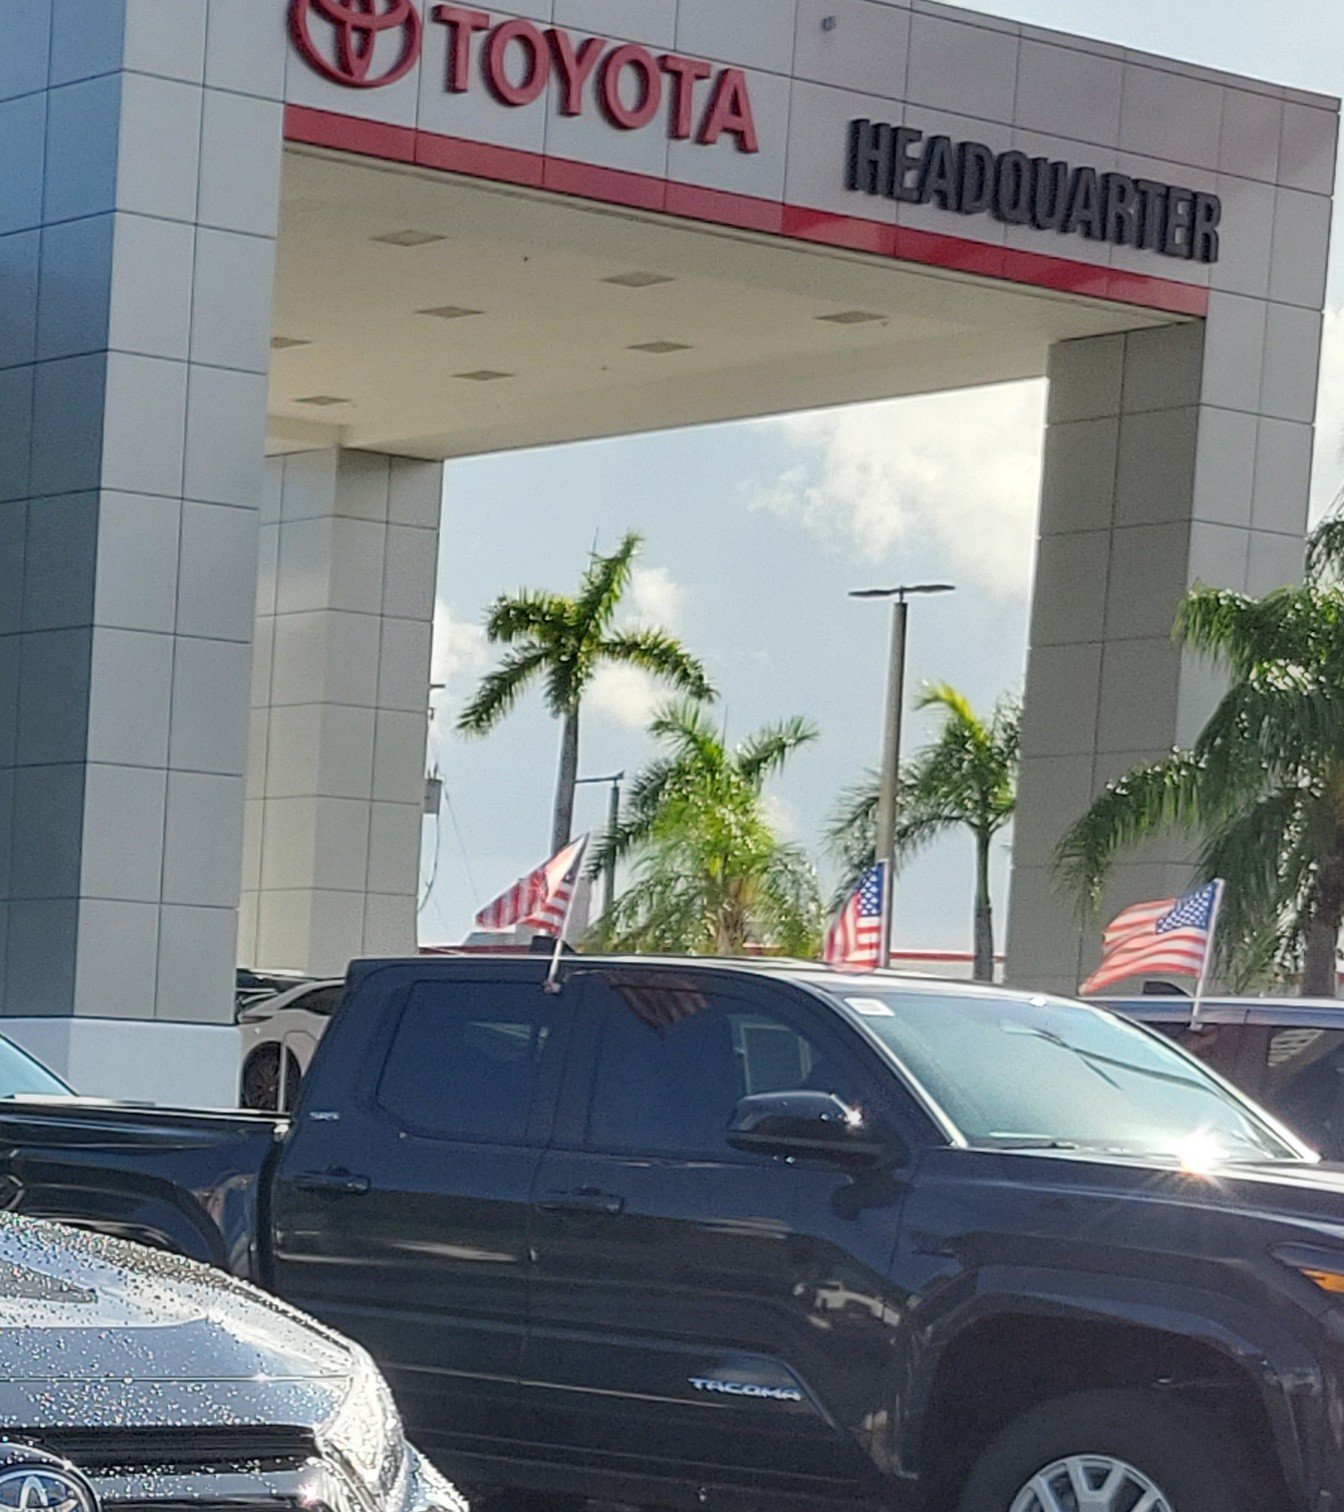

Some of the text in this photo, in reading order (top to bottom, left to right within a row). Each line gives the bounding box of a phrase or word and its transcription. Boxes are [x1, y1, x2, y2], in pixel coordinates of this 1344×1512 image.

[431, 4, 759, 154] TOYOTA
[843, 118, 1222, 263] HEADQUARTER
[687, 1377, 801, 1401] TACOMA
